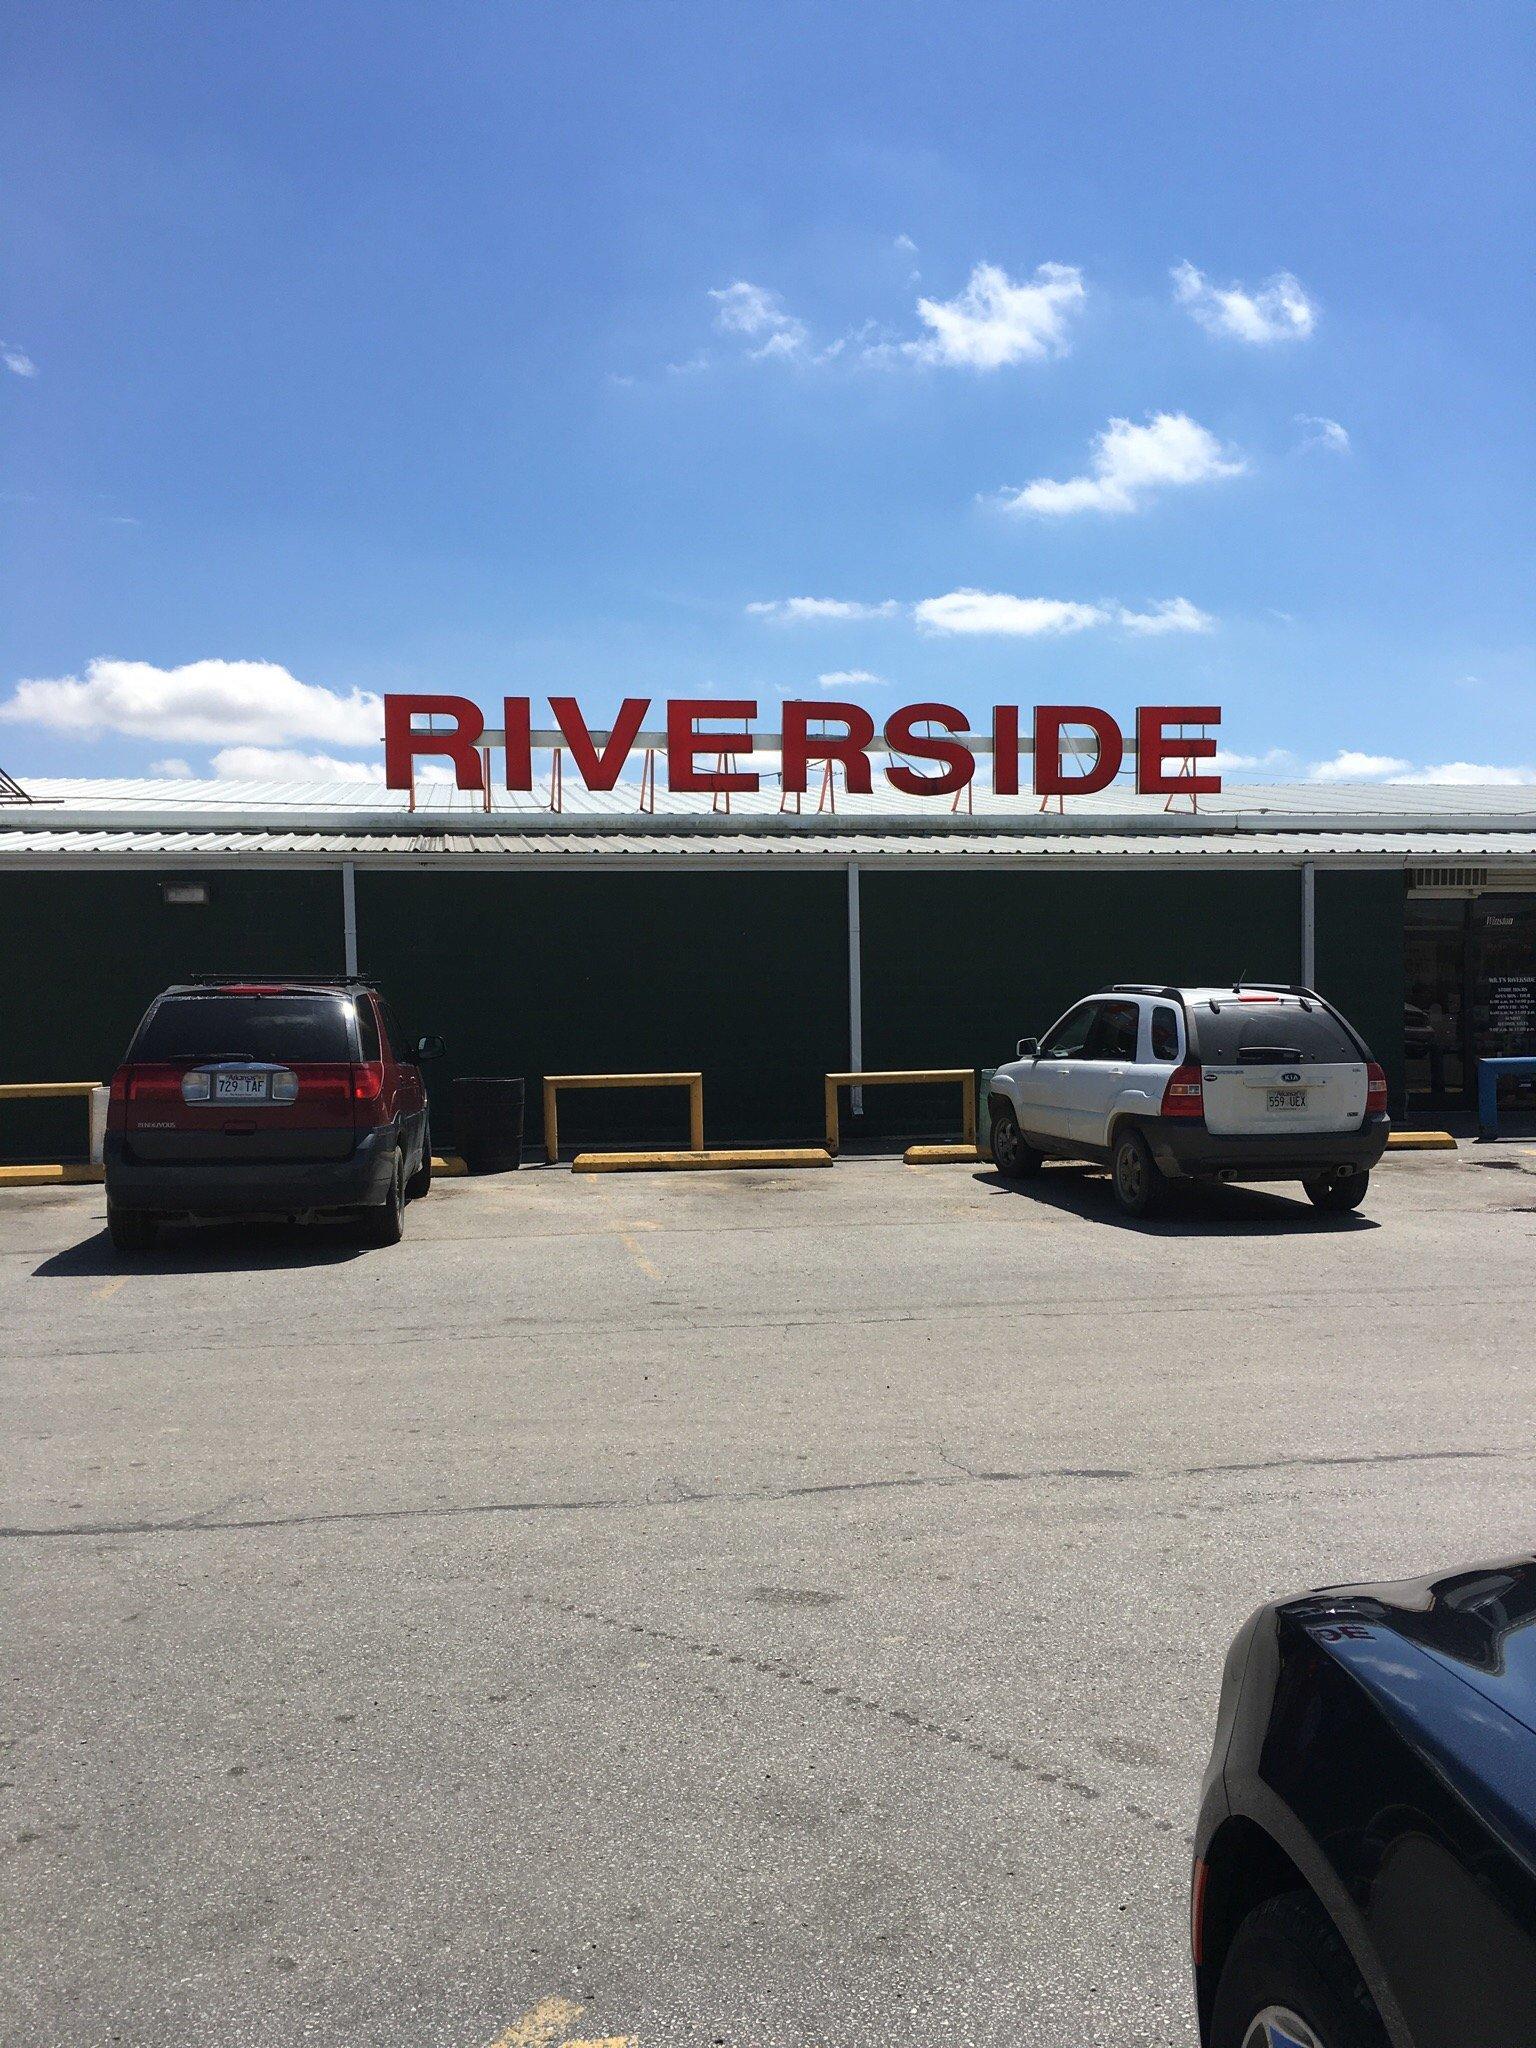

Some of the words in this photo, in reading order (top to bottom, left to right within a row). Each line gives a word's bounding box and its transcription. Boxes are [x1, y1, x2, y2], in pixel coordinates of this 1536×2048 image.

[385, 694, 1222, 795] RIVERSIDE
[1284, 1073, 1300, 1082] KIA
[218, 1080, 239, 1092] 729
[245, 1080, 265, 1092] TAF
[1269, 1096, 1285, 1107] 559
[1289, 1096, 1306, 1107] UEX
